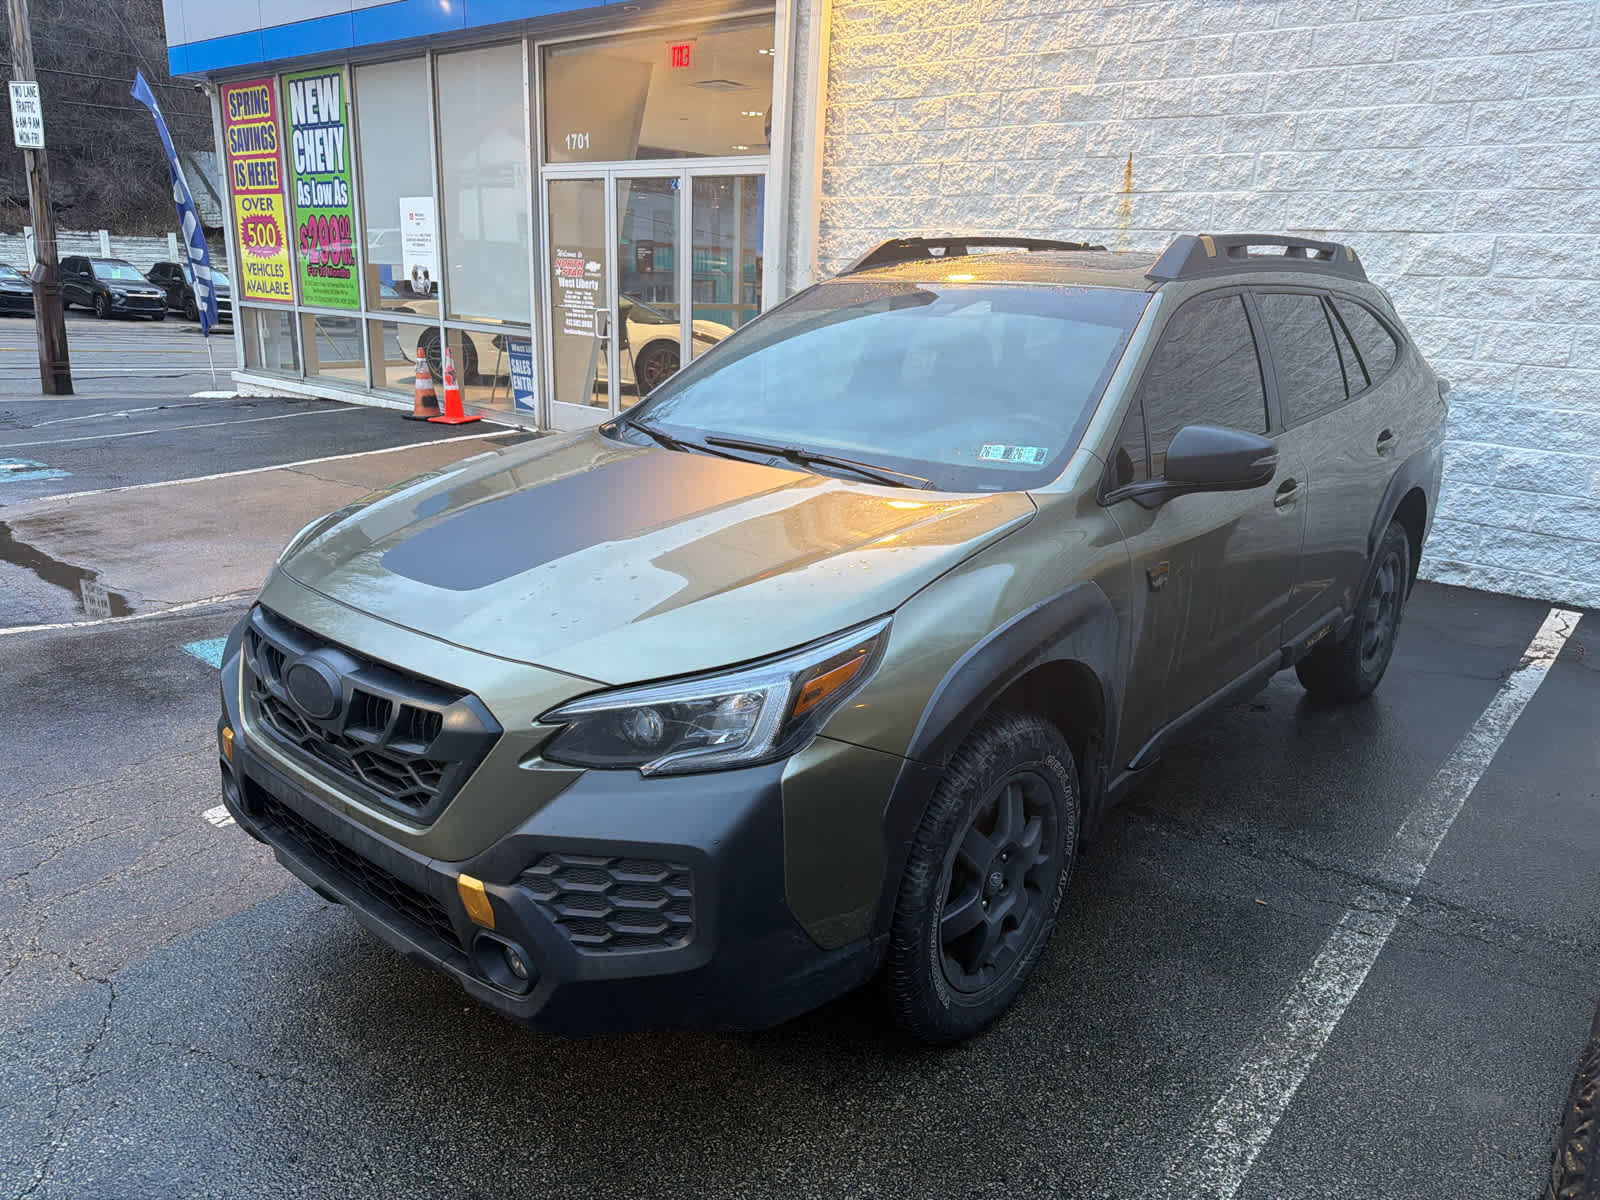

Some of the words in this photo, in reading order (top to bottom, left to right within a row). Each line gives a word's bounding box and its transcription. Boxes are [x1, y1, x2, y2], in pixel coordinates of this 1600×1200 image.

[11, 85, 22, 98] TWO
[23, 85, 38, 98] LANE
[289, 74, 341, 126] NEW
[228, 86, 270, 118] SPRING
[229, 123, 276, 154] SAVINGS
[565, 132, 590, 150] 1701
[292, 126, 345, 174] CHEVY
[234, 161, 246, 187] IS
[248, 158, 278, 187] HERE!
[241, 197, 274, 212] OVER
[247, 222, 277, 248] 500
[246, 262, 284, 278] VEHICLES
[555, 258, 584, 269] NORTH
[561, 268, 583, 278] STAR
[246, 280, 290, 296] AVAILABLE
[511, 357, 532, 376] SALES
